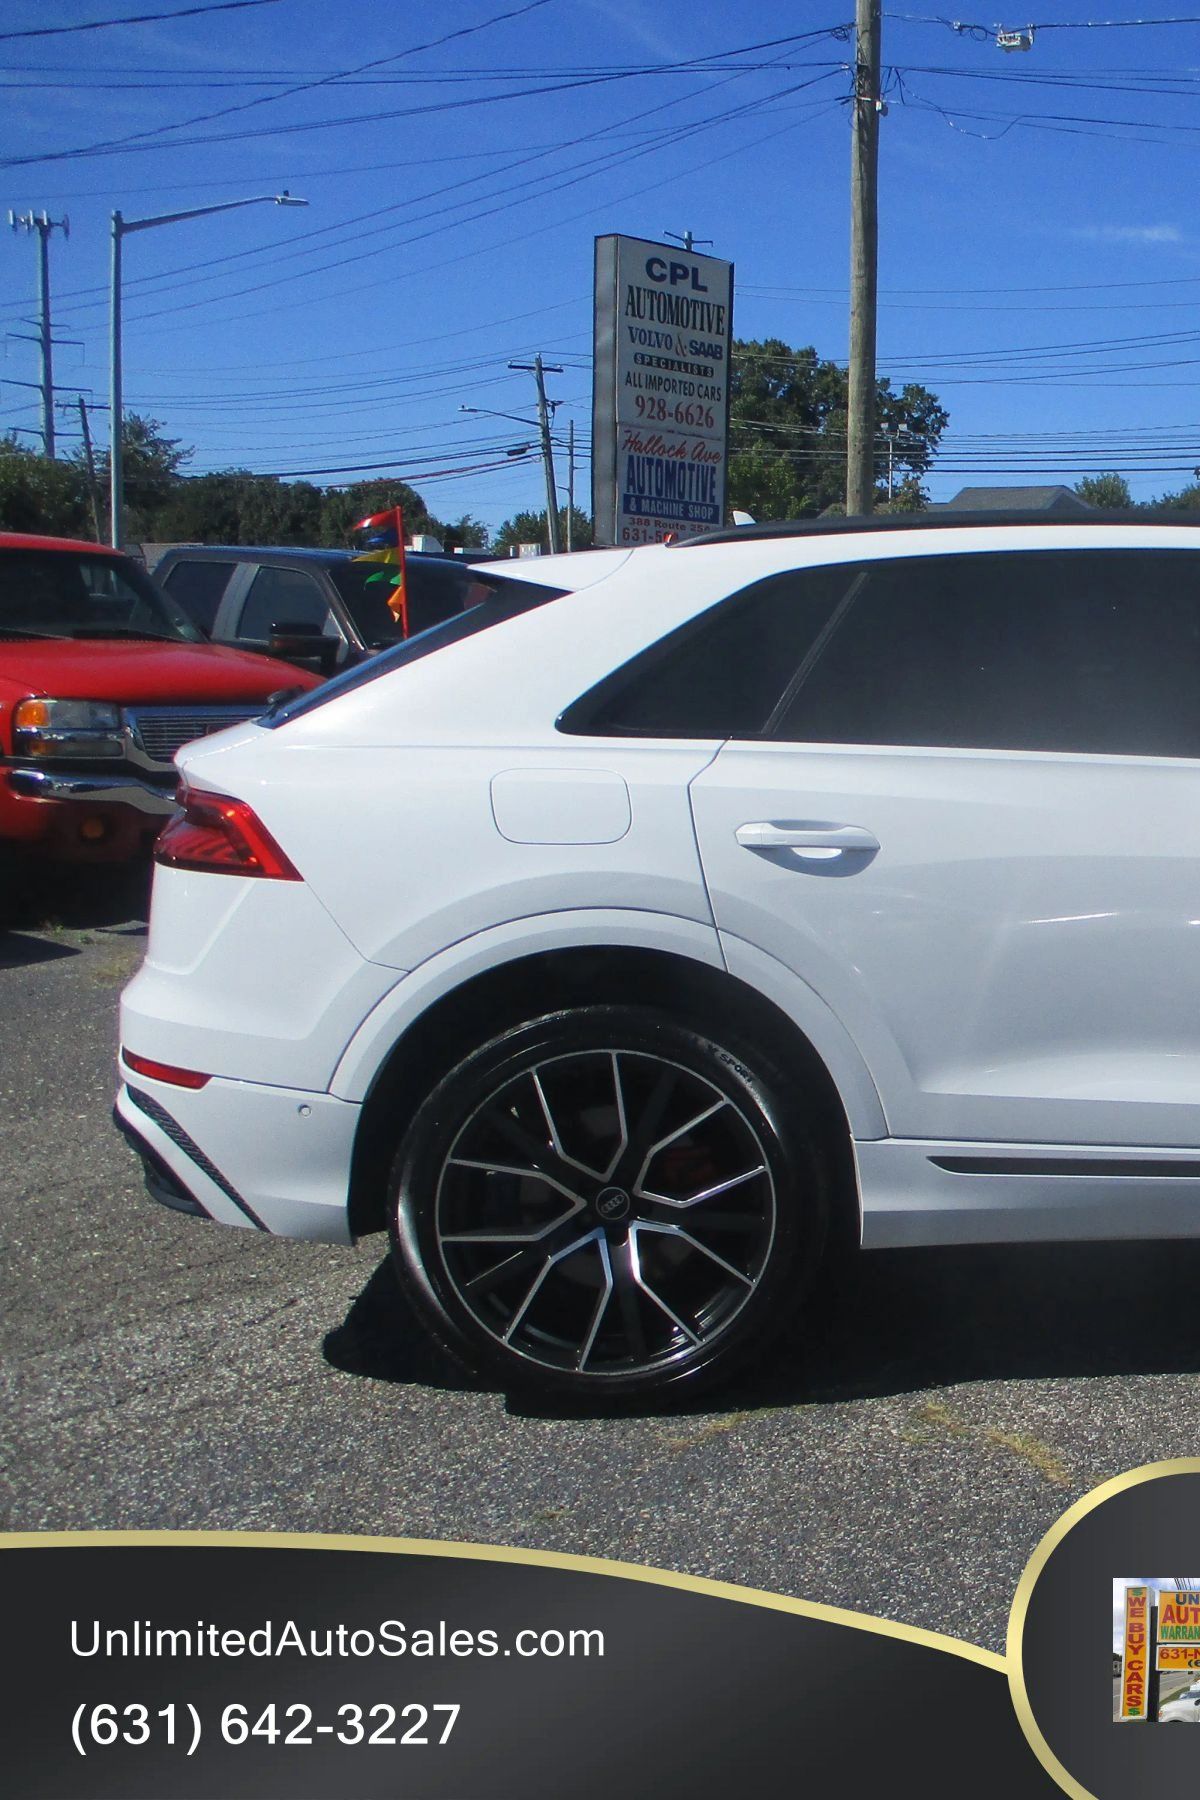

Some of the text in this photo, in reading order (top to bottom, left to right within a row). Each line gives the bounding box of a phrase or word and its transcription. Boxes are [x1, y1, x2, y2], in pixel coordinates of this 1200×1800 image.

[645, 257, 708, 292] CPL
[625, 284, 725, 336] AUTOMOTIVE
[628, 326, 673, 351] VOLVO
[689, 339, 723, 361] SAAB
[635, 354, 713, 378] SPECIALISTS
[625, 371, 722, 401] ALL IMPORTED CARS
[635, 394, 714, 429] 928-6626
[622, 429, 722, 464] Hallock Ave
[626, 454, 717, 504] AUTOMOTIVE
[629, 497, 714, 519] & MACHINE SHOP
[654, 519, 687, 532] Route
[622, 527, 679, 544] 631-5
